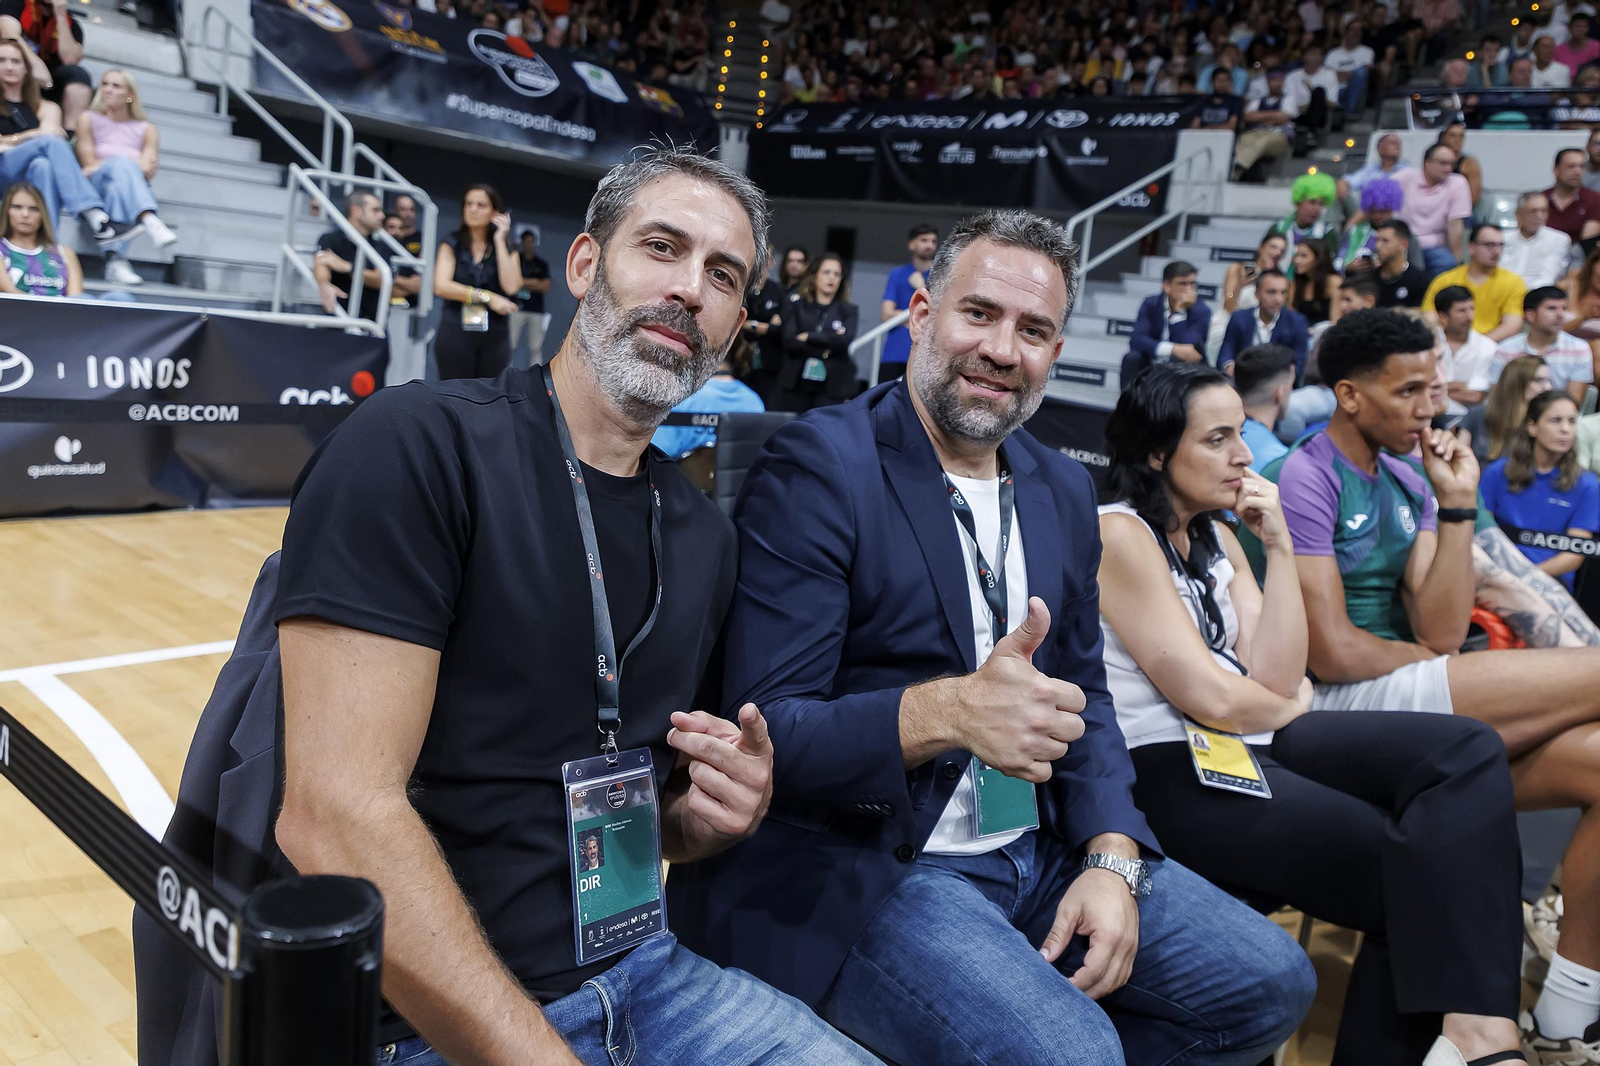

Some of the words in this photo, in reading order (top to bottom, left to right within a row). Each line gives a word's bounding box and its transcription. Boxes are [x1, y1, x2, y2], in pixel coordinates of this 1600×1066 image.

[1109, 111, 1180, 127] IONOS
[87, 355, 191, 389] IONOS
[128, 403, 239, 422] @ACBCOM
[565, 459, 576, 479] acb
[953, 489, 964, 505] acb
[588, 553, 596, 575] acb
[986, 570, 995, 589] acb
[597, 654, 608, 677] acb
[580, 874, 601, 893] DIR
[584, 912, 588, 921] 1
